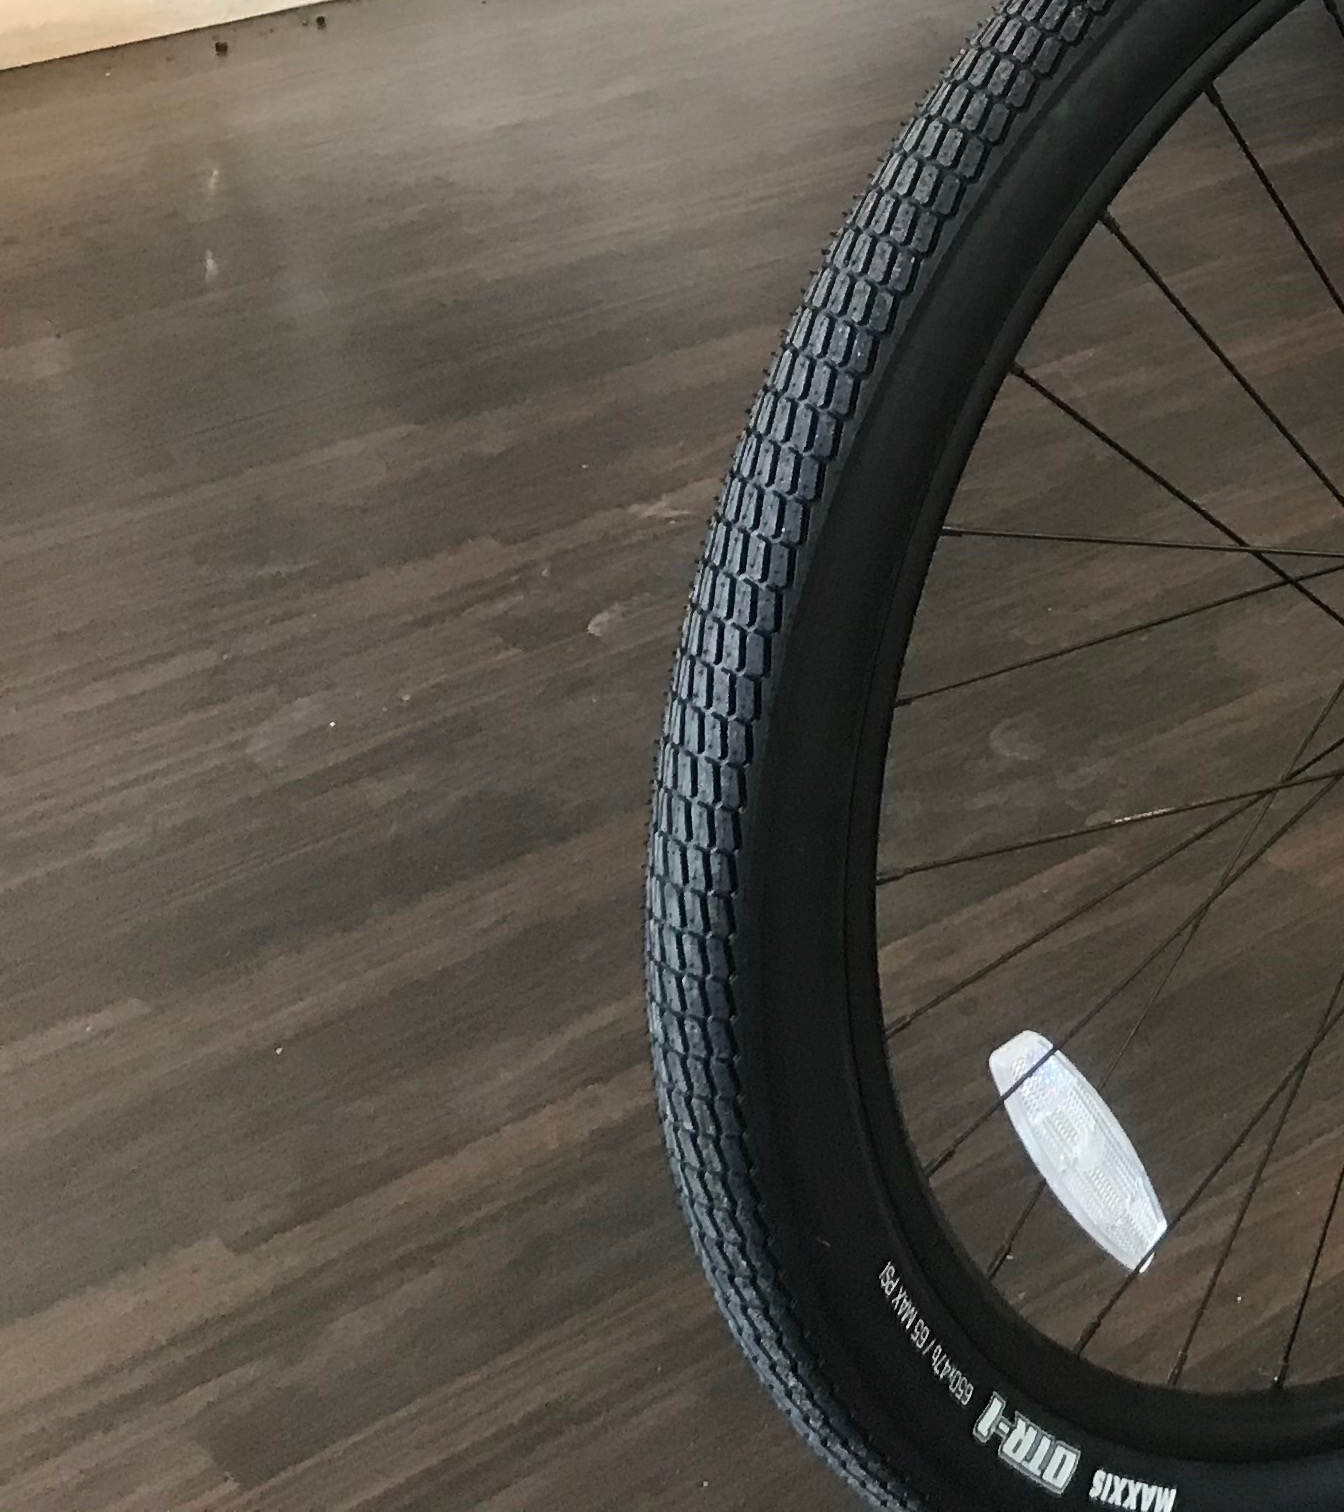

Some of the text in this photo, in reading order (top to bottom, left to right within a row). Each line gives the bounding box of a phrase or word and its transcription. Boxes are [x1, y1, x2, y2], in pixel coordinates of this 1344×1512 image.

[877, 1259, 900, 1299] PSI
[888, 1286, 918, 1331] MAX
[1089, 1468, 1177, 1512] MAXXIS
